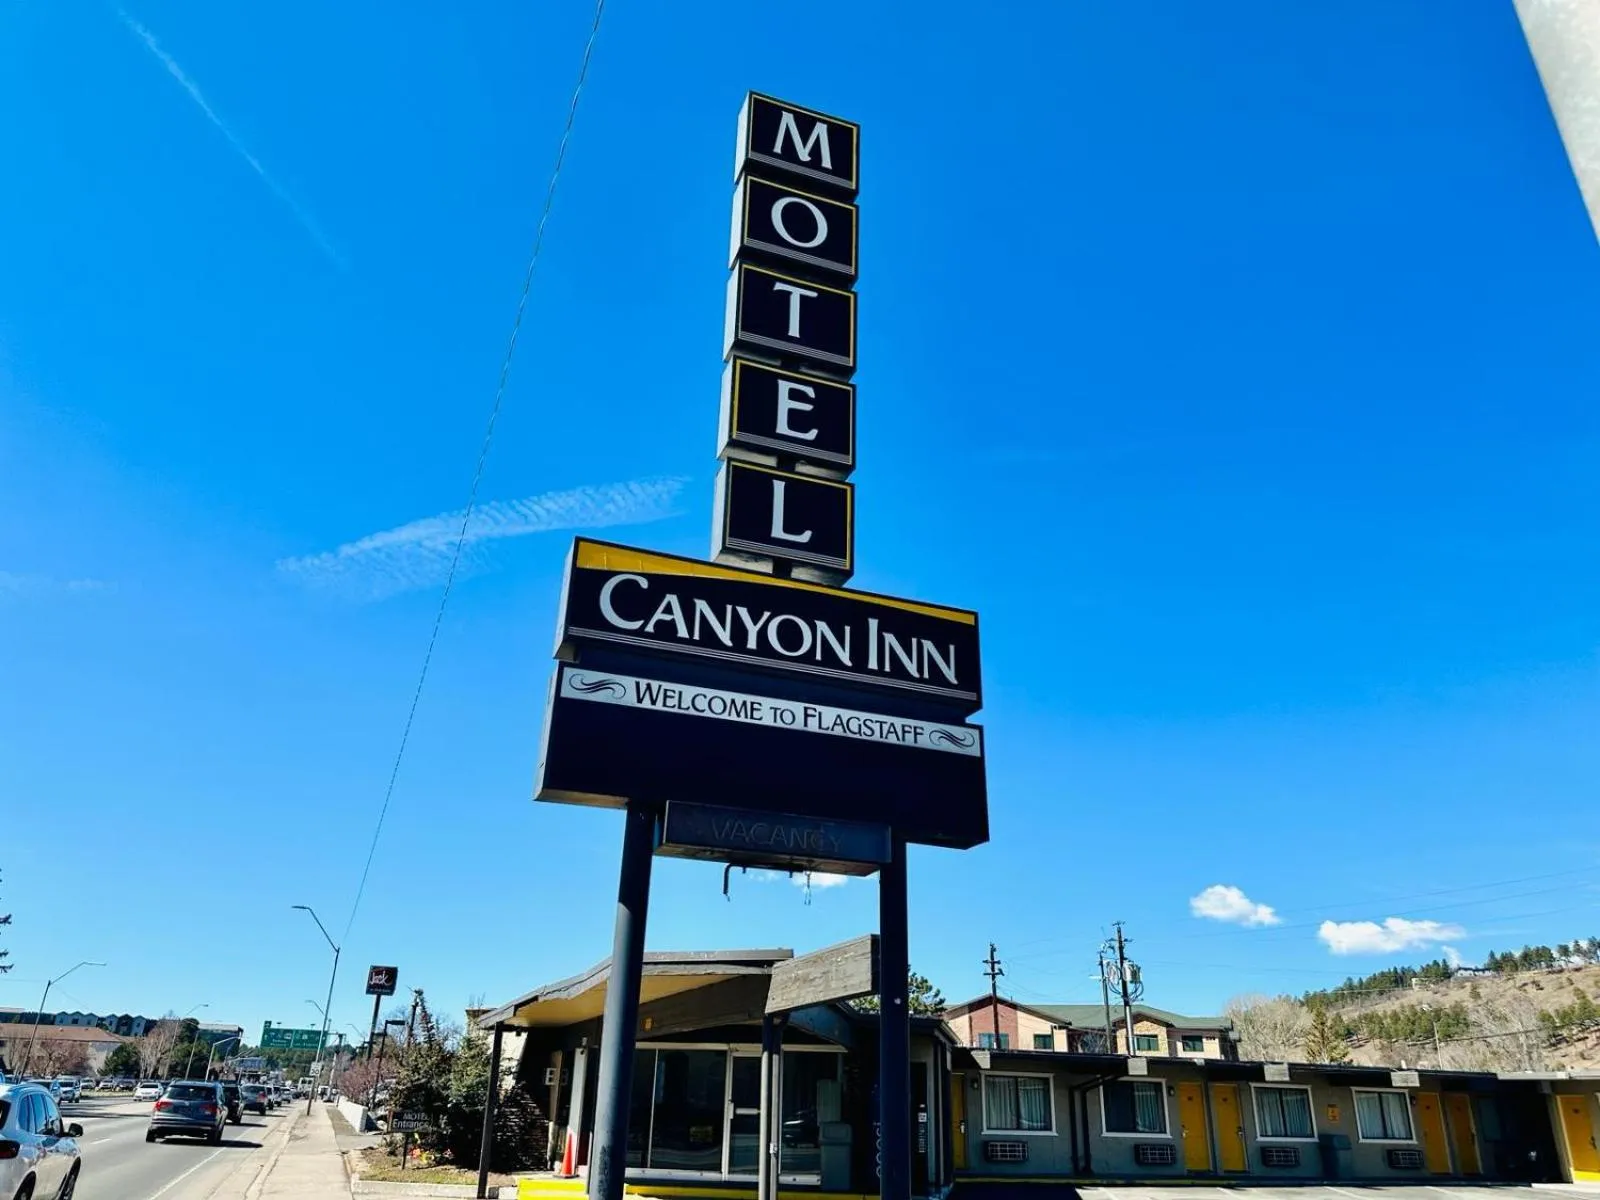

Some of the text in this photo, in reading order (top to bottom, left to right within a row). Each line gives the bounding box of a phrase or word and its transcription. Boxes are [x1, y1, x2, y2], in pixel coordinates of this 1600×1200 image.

[771, 110, 832, 545] MOTEL
[599, 573, 958, 686] CANYON INN
[634, 680, 925, 745] WELCOME TO FLAGSTAFF
[711, 817, 843, 852] VACANCY
